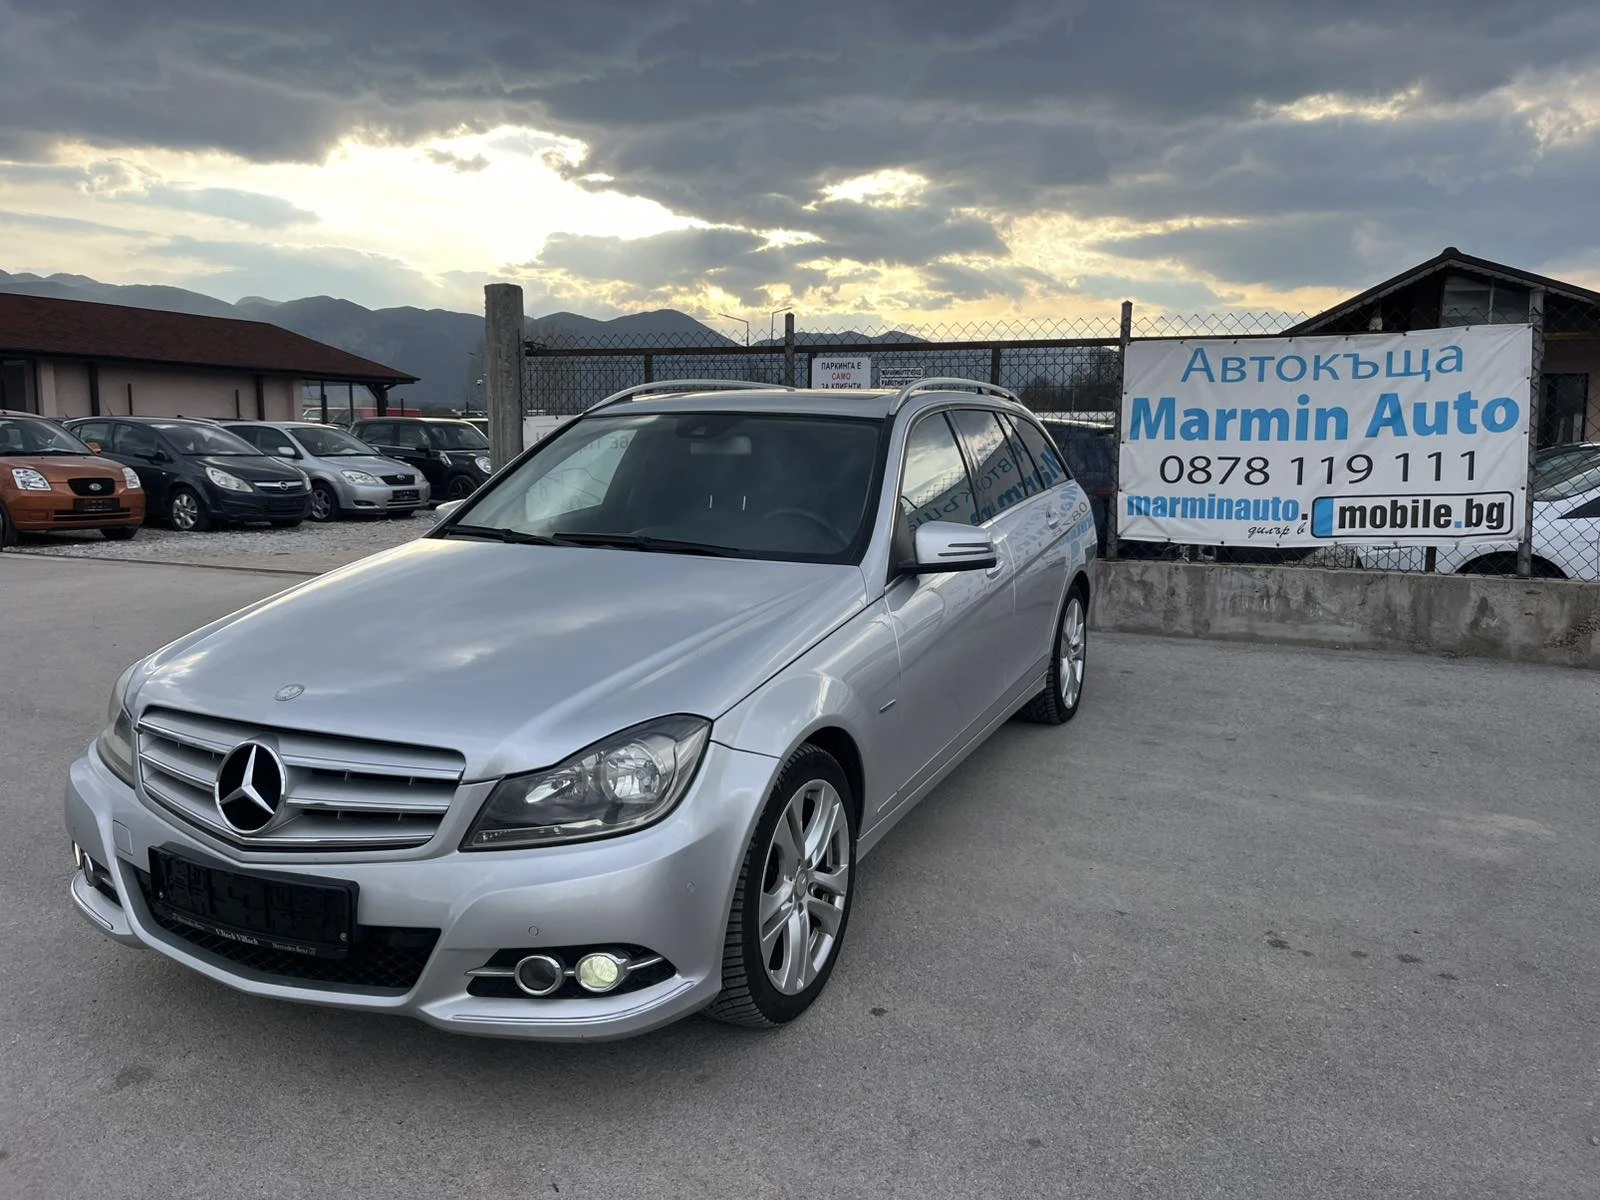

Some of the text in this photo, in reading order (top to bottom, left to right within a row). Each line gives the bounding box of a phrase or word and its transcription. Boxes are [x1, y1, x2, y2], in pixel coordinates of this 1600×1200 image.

[821, 362, 855, 370] ПАРКИНГА
[832, 372, 851, 380] САМО
[1181, 344, 1464, 383] Автокъща
[1129, 390, 1520, 441] Marmin Auto
[1159, 450, 1476, 486] 0878 119 111
[1338, 499, 1505, 530] mobile.bg
